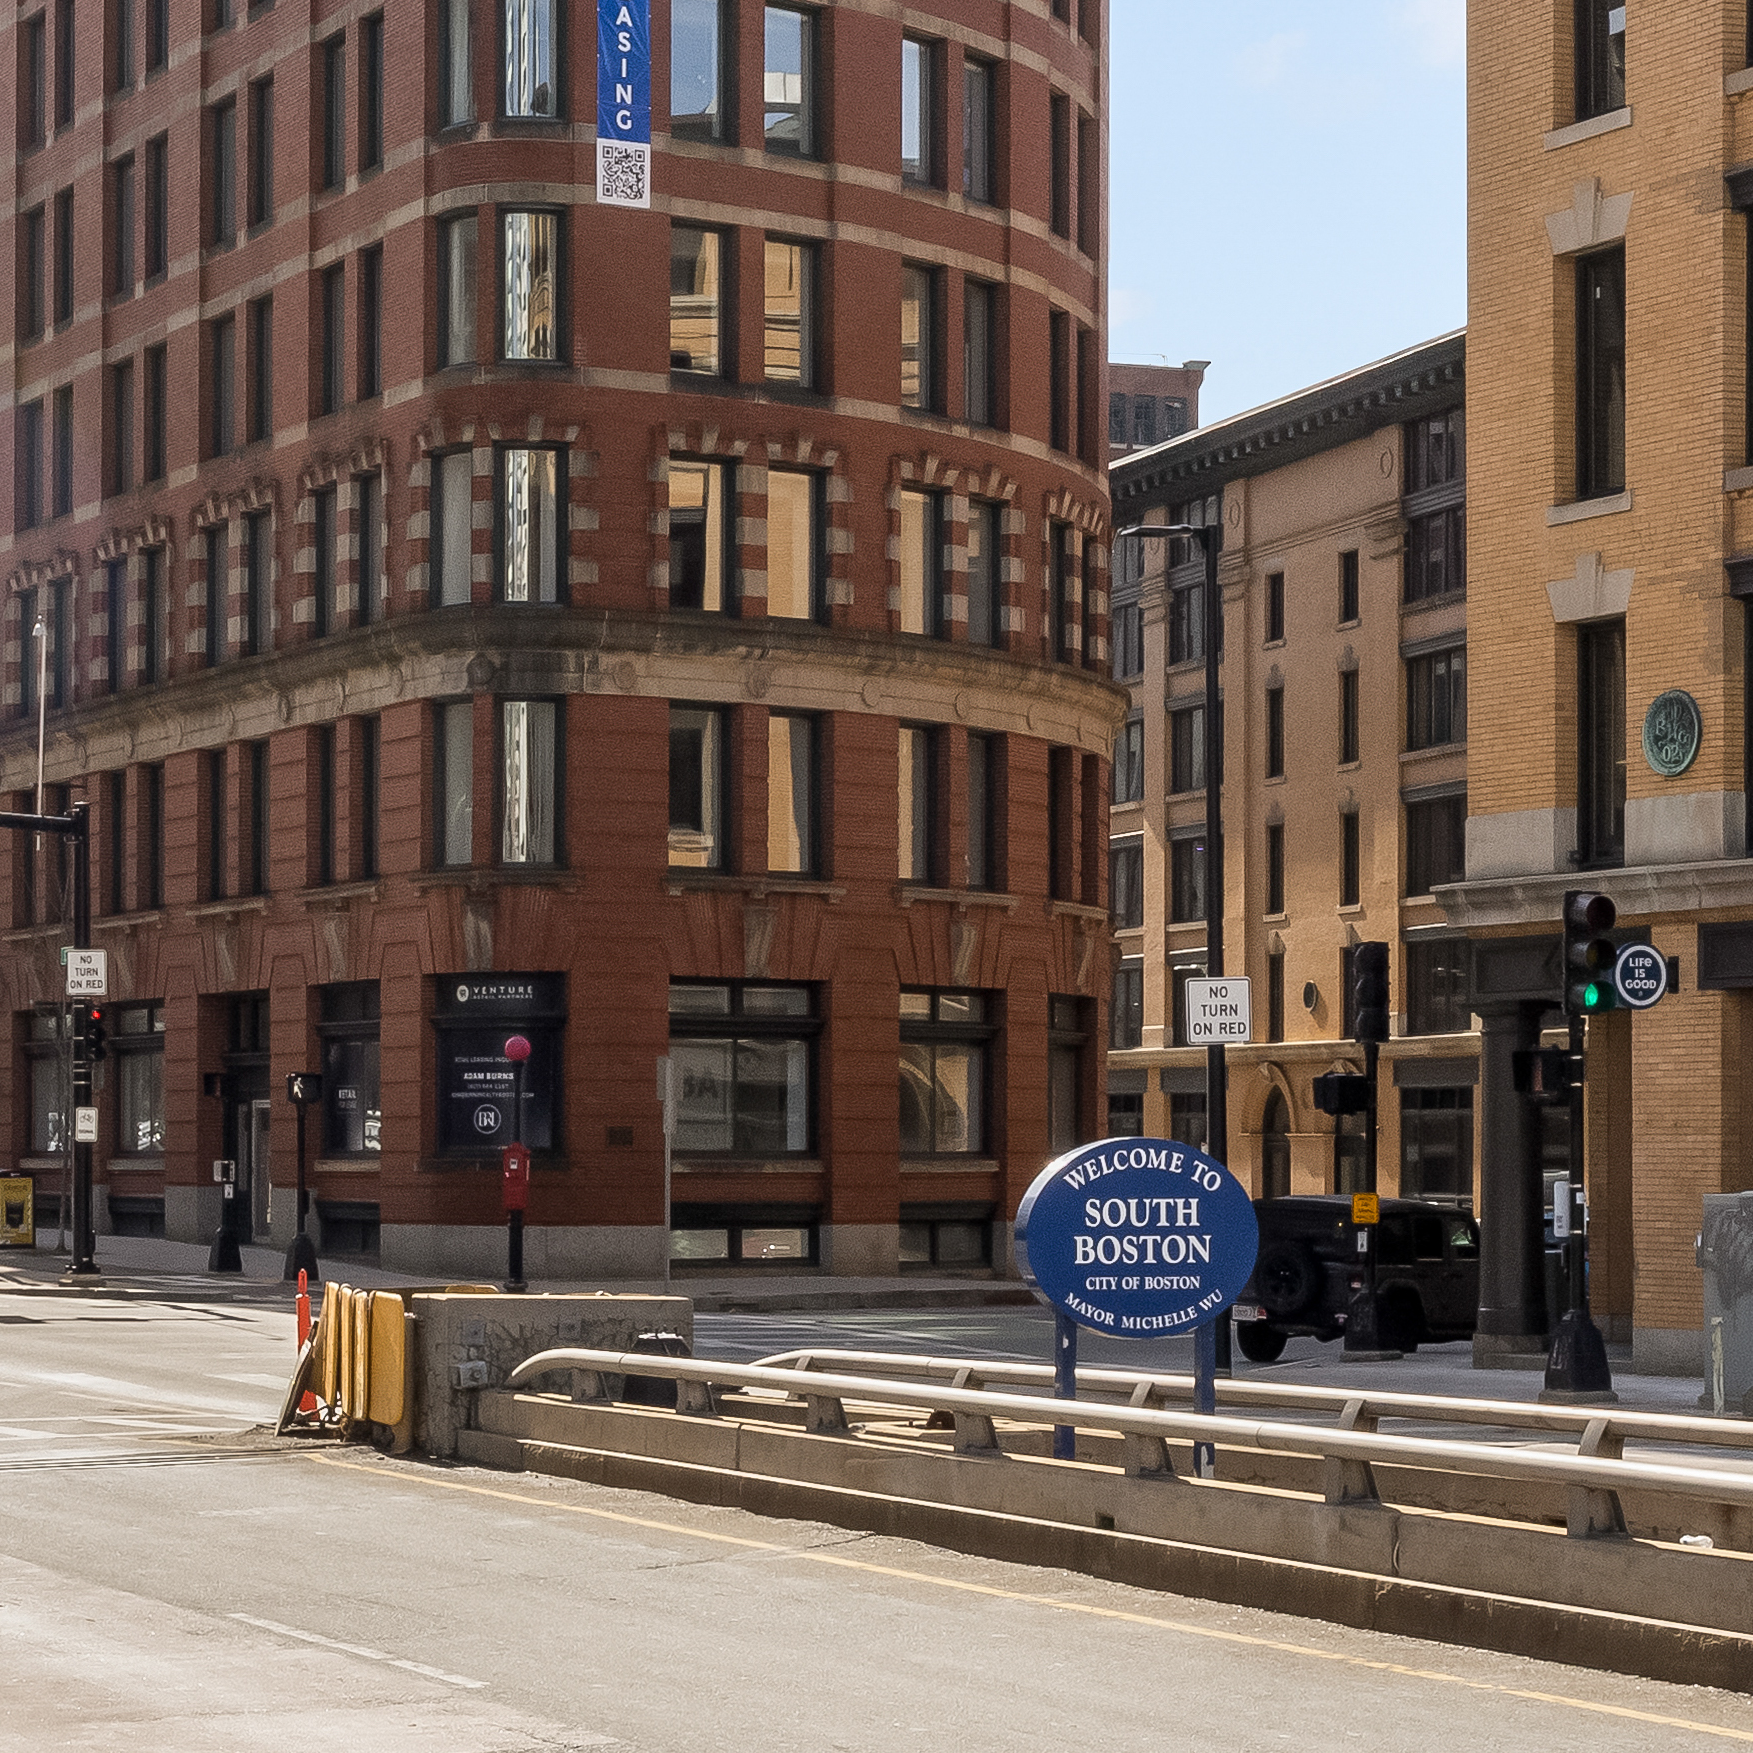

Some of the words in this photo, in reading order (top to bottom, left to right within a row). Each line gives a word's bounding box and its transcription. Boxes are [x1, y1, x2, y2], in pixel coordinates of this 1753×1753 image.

[80, 955, 93, 964] NO
[75, 967, 99, 977] TURN
[1634, 968, 1646, 978] IS
[70, 979, 83, 989] ON
[86, 979, 104, 989] RED
[473, 985, 533, 995] VENTURE
[1625, 979, 1657, 989] GOOD
[1209, 986, 1228, 999] NO
[1201, 1003, 1239, 1017] TURN
[1193, 1022, 1213, 1036] ON
[1219, 1022, 1247, 1035] RED
[1062, 1147, 1185, 1191] WELCOME
[1190, 1159, 1222, 1192] TO
[1085, 1198, 1201, 1228] SOUTH
[1073, 1234, 1212, 1265] BOSTON
[1085, 1276, 1119, 1291] CITY
[1121, 1276, 1140, 1290] OF
[1144, 1275, 1201, 1290] BOSTON
[1064, 1292, 1115, 1327] MAYOR
[1120, 1305, 1198, 1330] MICHELLE
[1198, 1288, 1224, 1312] WU
